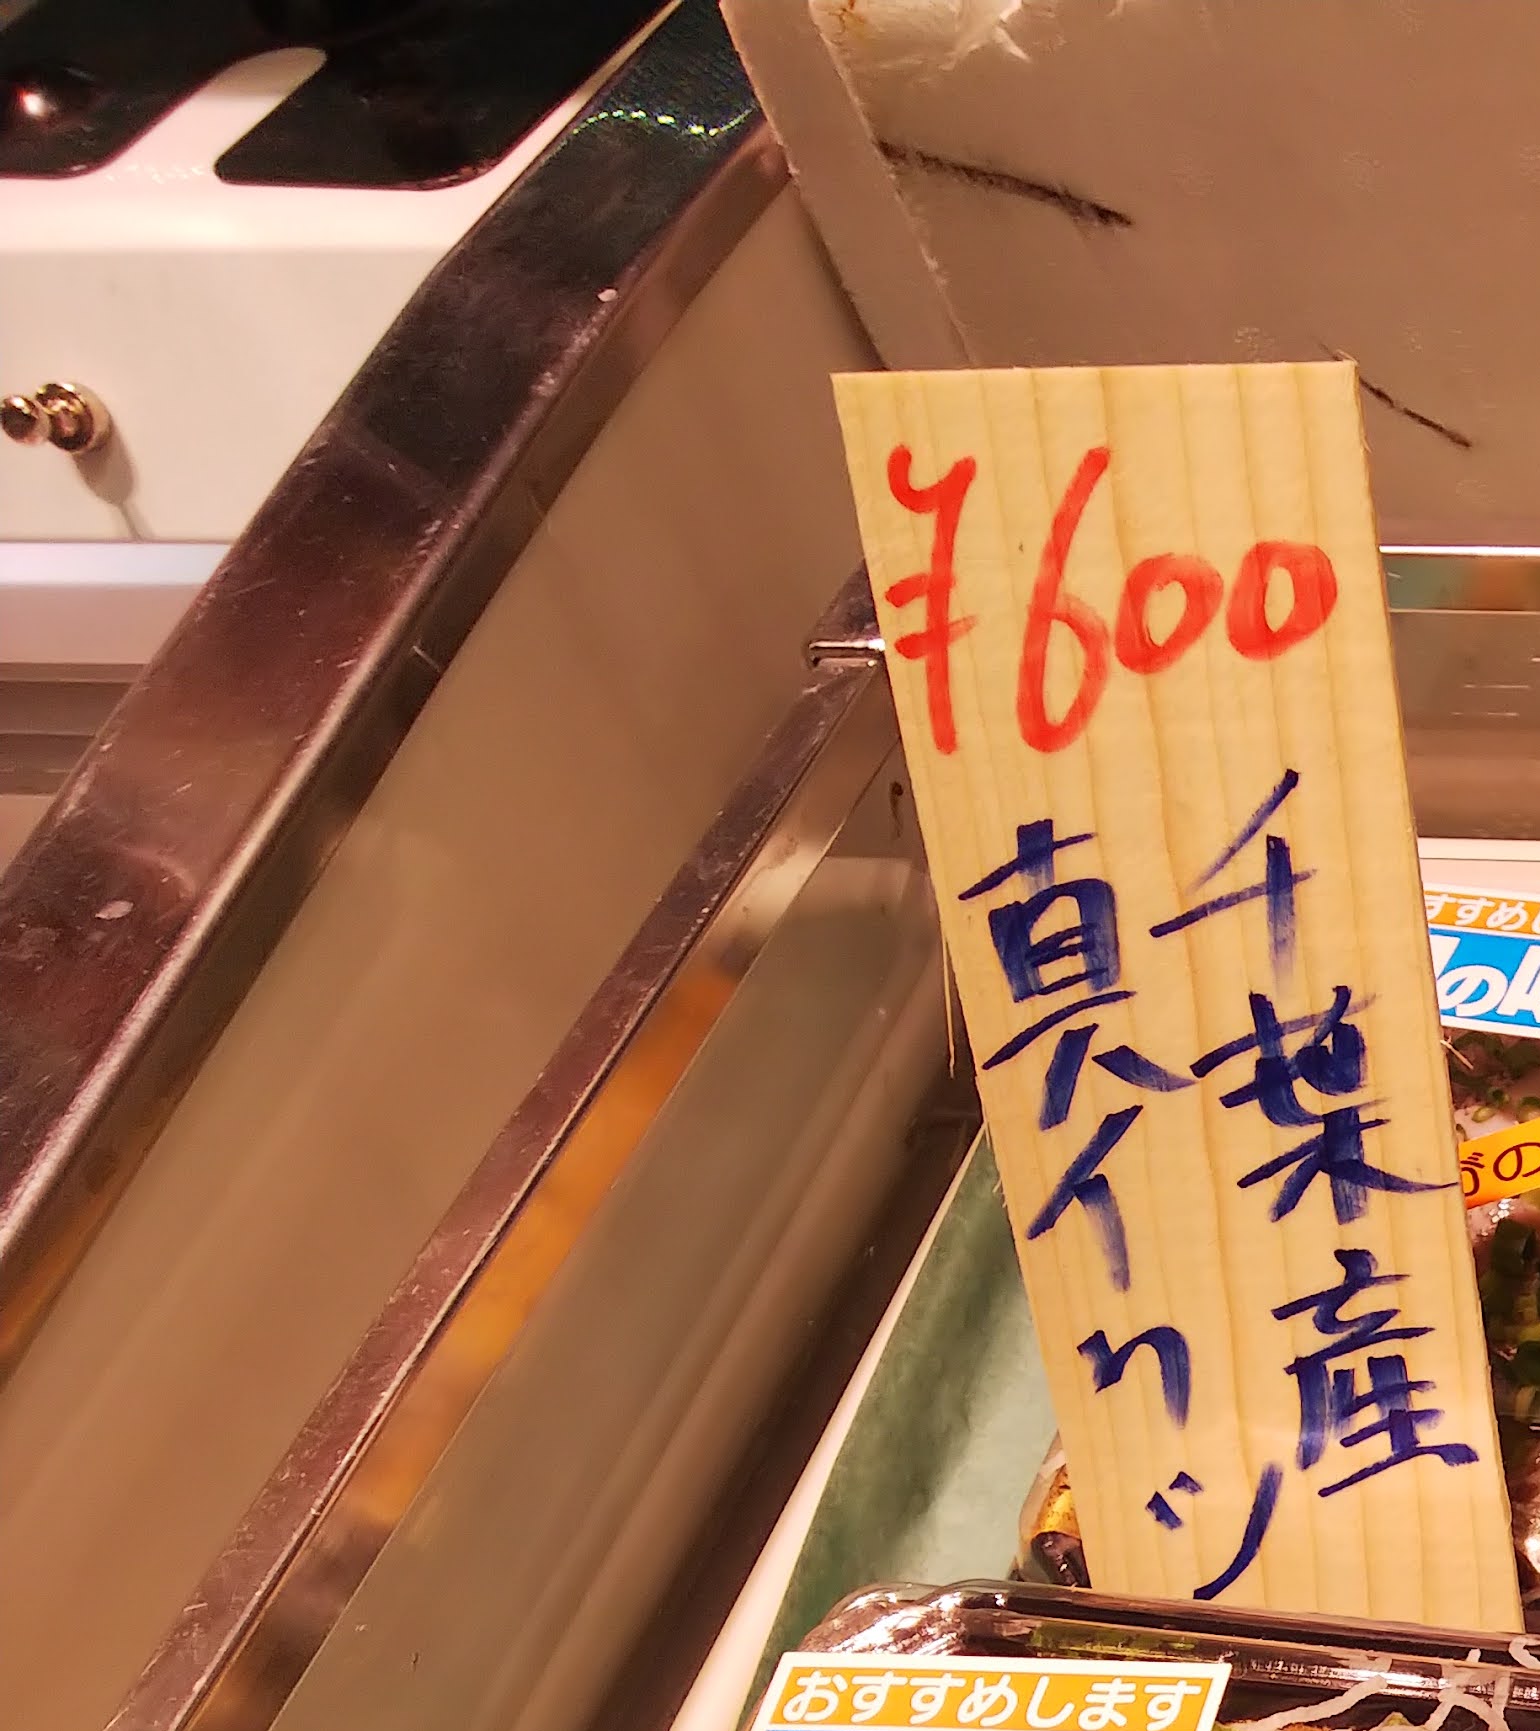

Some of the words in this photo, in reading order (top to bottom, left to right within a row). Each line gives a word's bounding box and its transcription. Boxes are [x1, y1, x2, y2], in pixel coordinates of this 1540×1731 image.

[884, 444, 1338, 755] ¥600
[1150, 768, 1479, 1497] 千葉産
[782, 1670, 1200, 1731] おすすめします
